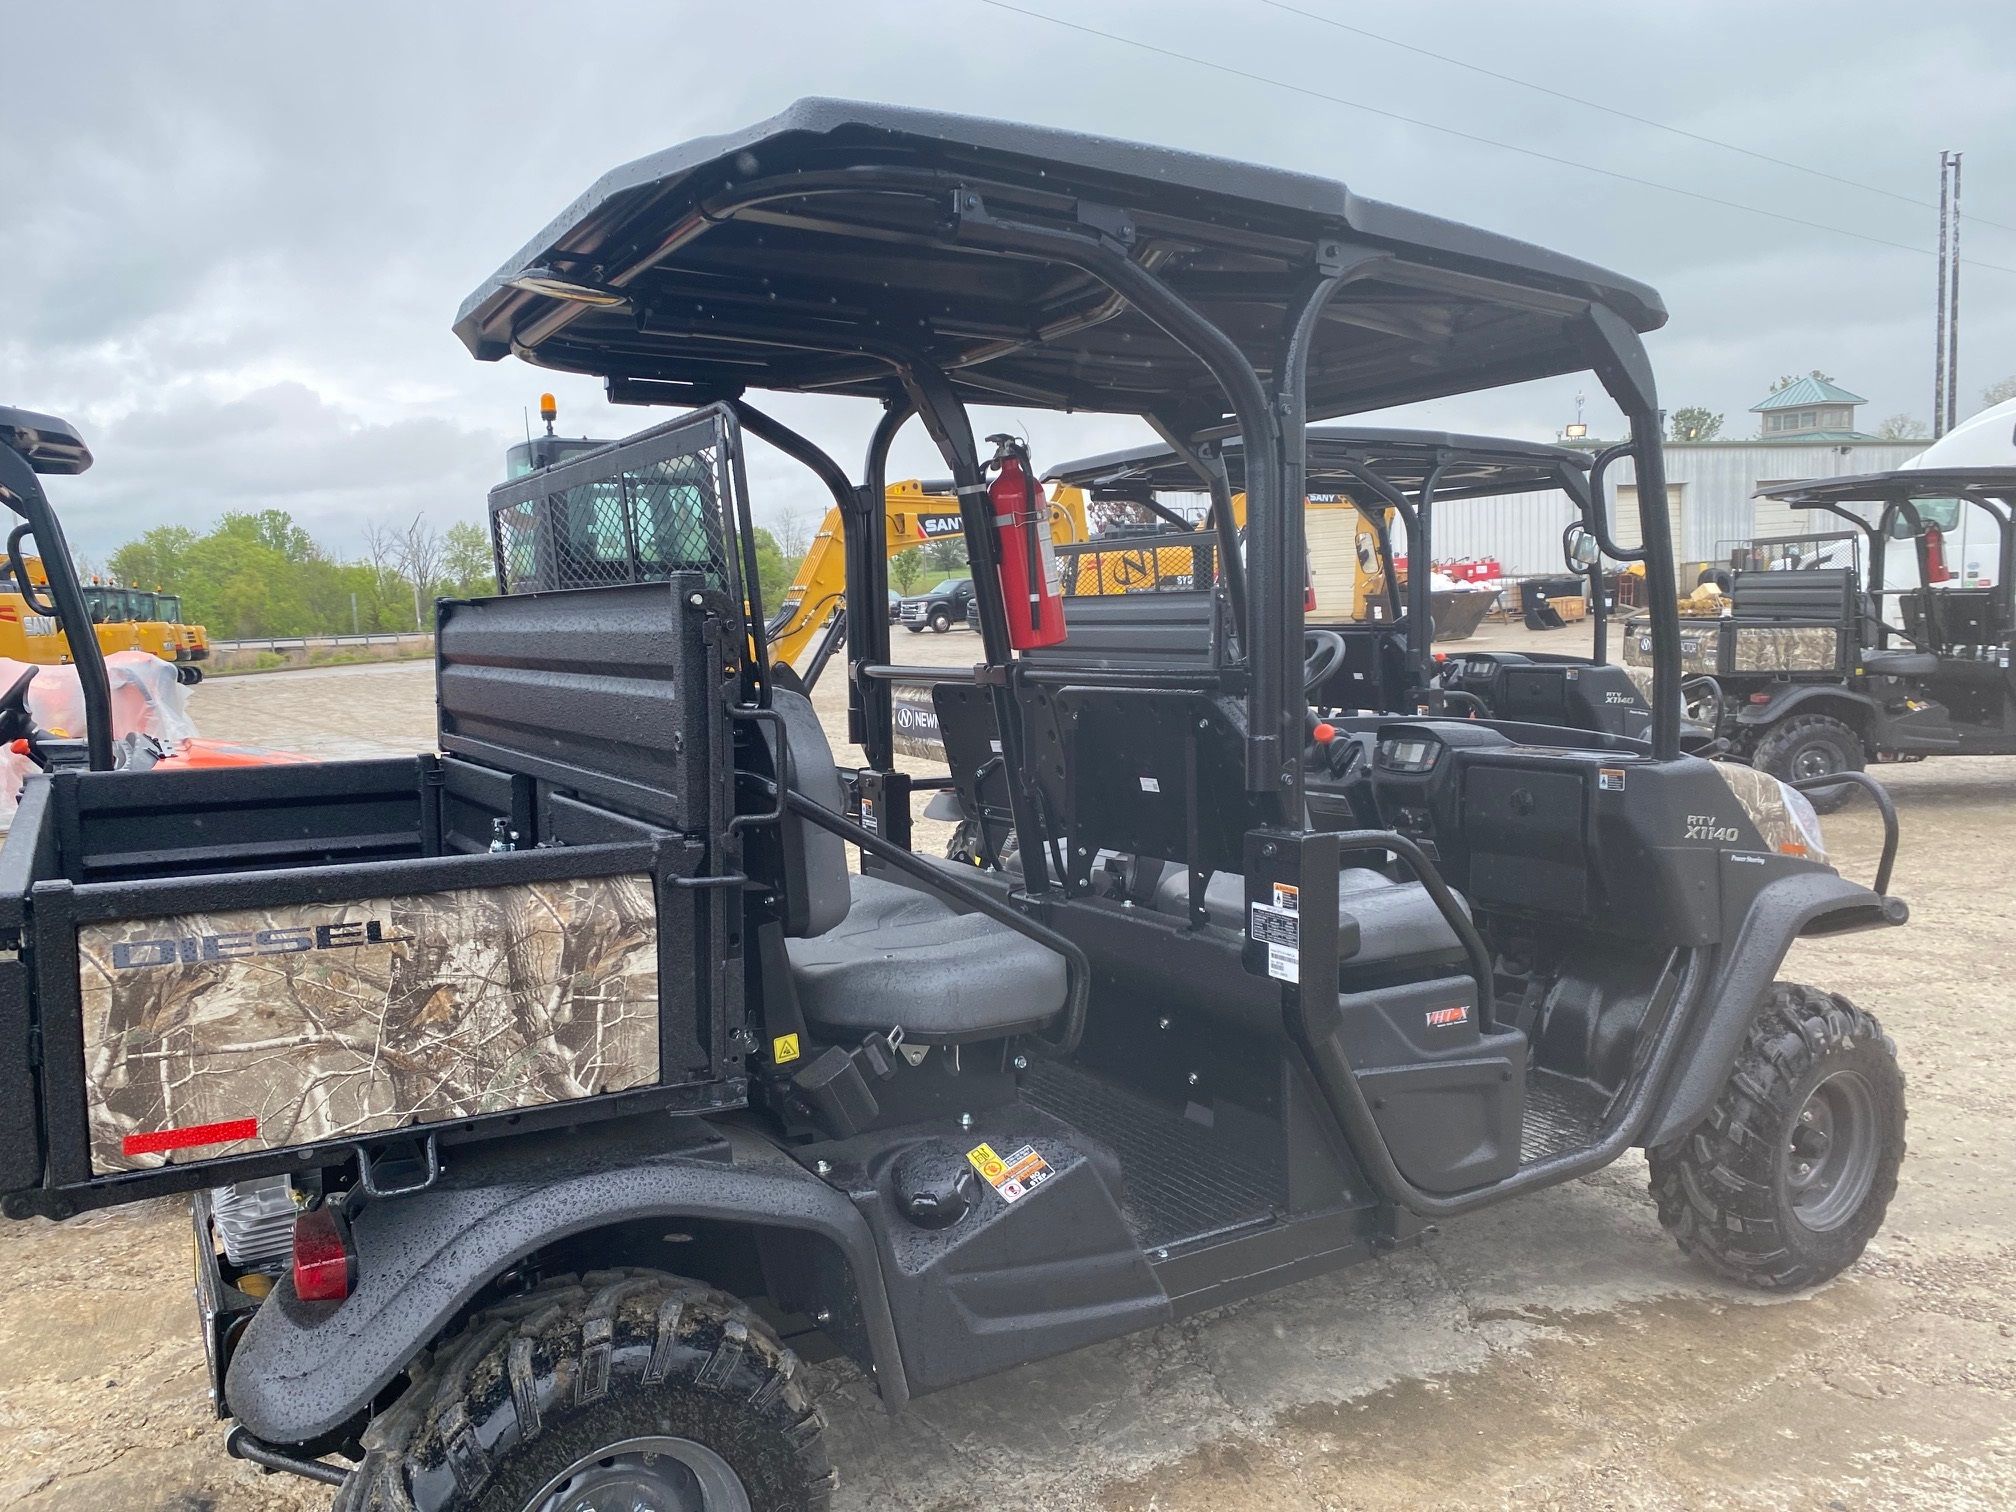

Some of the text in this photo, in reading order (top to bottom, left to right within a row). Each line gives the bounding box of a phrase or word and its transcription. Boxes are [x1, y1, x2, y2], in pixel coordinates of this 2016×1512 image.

[1309, 494, 1335, 502] SANY
[23, 615, 57, 636] SANY
[1687, 815, 1716, 826] RTV
[1683, 825, 1739, 842] X1140
[112, 919, 416, 970] DIESEL
[1029, 1171, 1041, 1180] NO
[1029, 1172, 1047, 1186] STEP
